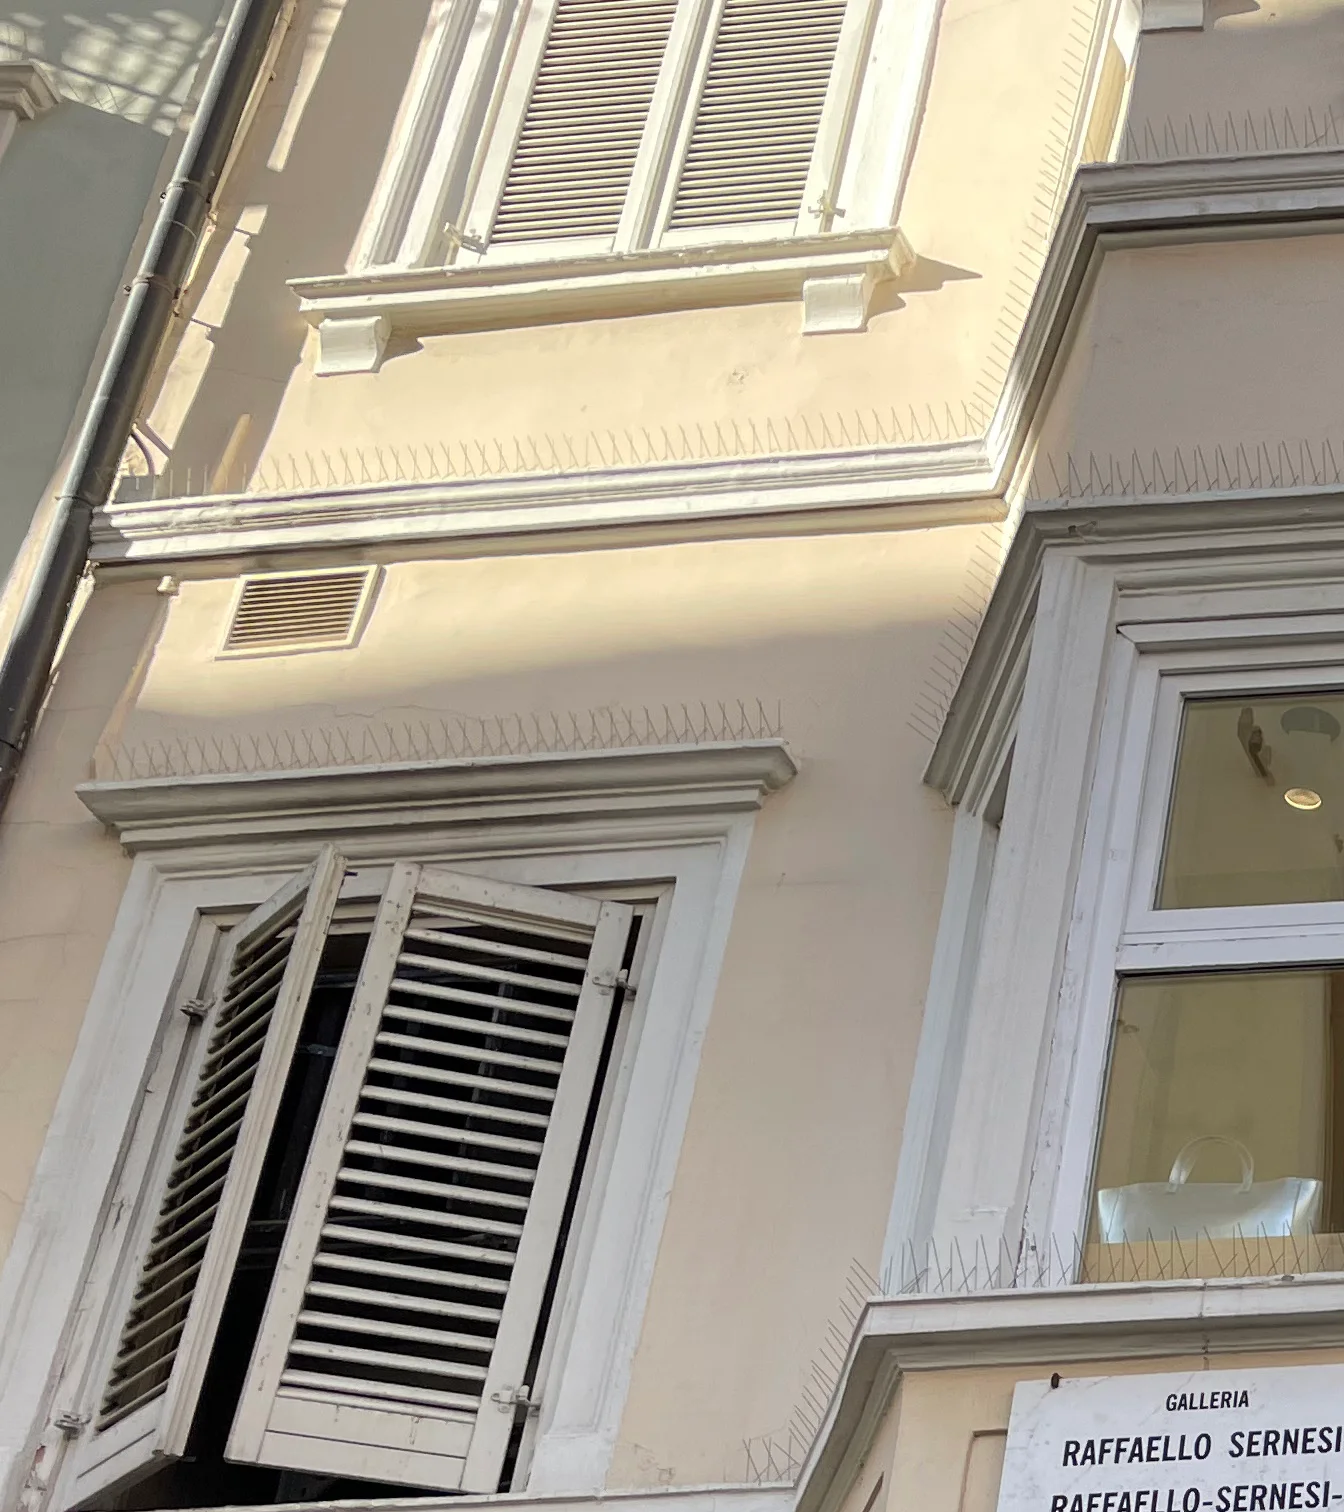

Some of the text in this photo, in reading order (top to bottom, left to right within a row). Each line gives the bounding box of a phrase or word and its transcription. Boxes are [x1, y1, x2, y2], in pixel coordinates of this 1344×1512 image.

[1165, 1389, 1250, 1412] GALLERIA
[1062, 1426, 1343, 1467] RAFFAELLO SERNESI
